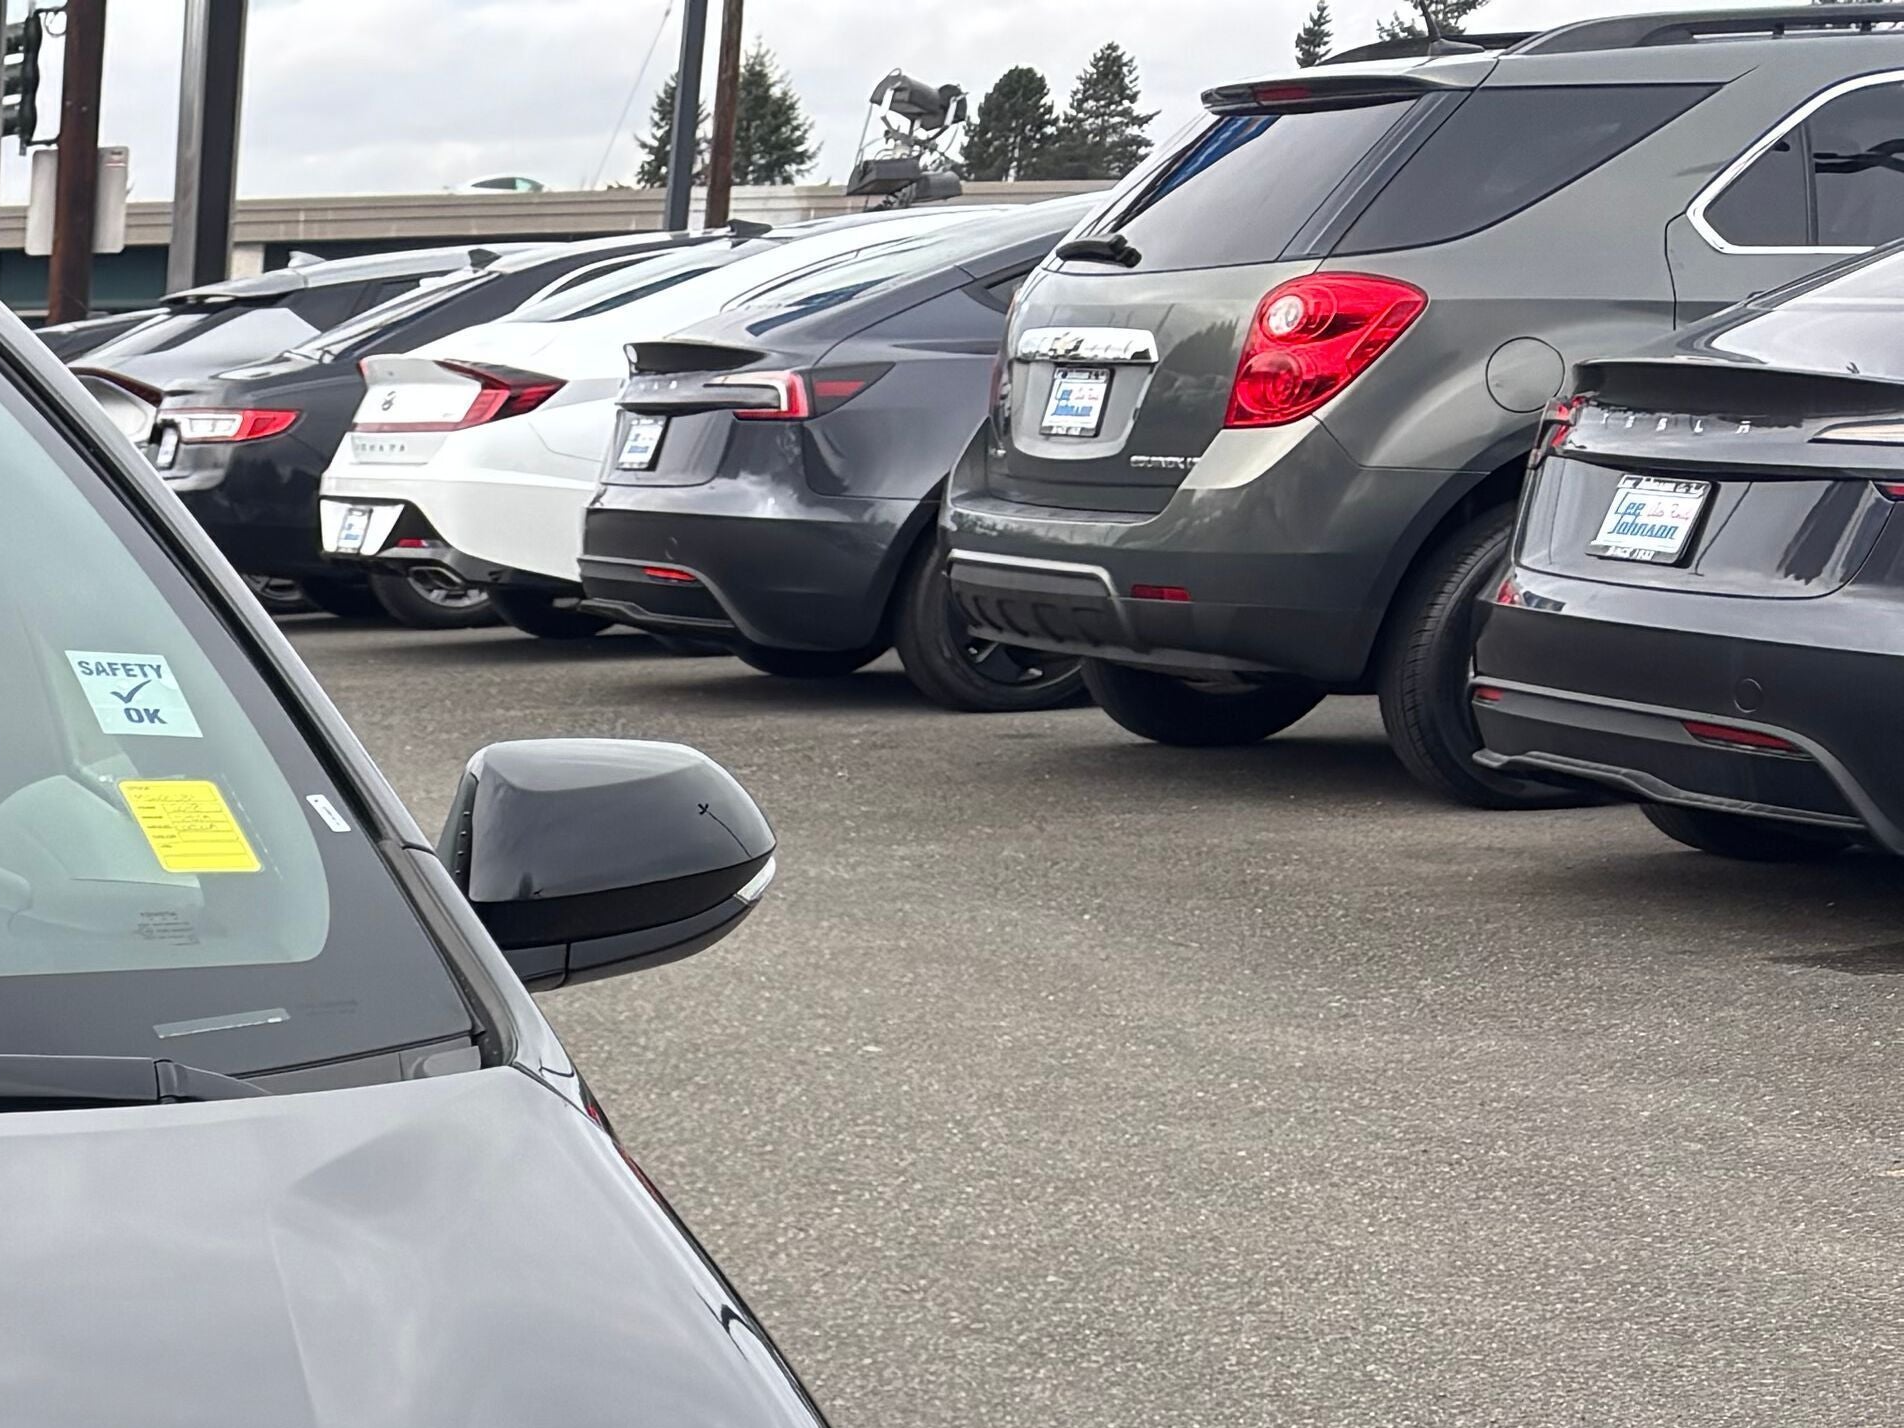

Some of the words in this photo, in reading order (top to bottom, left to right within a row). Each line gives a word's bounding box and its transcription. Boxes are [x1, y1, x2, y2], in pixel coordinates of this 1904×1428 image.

[1614, 491, 1646, 516] Lee
[1607, 516, 1679, 540] Johnson
[77, 660, 163, 679] SAFETY
[123, 707, 169, 724] OK
